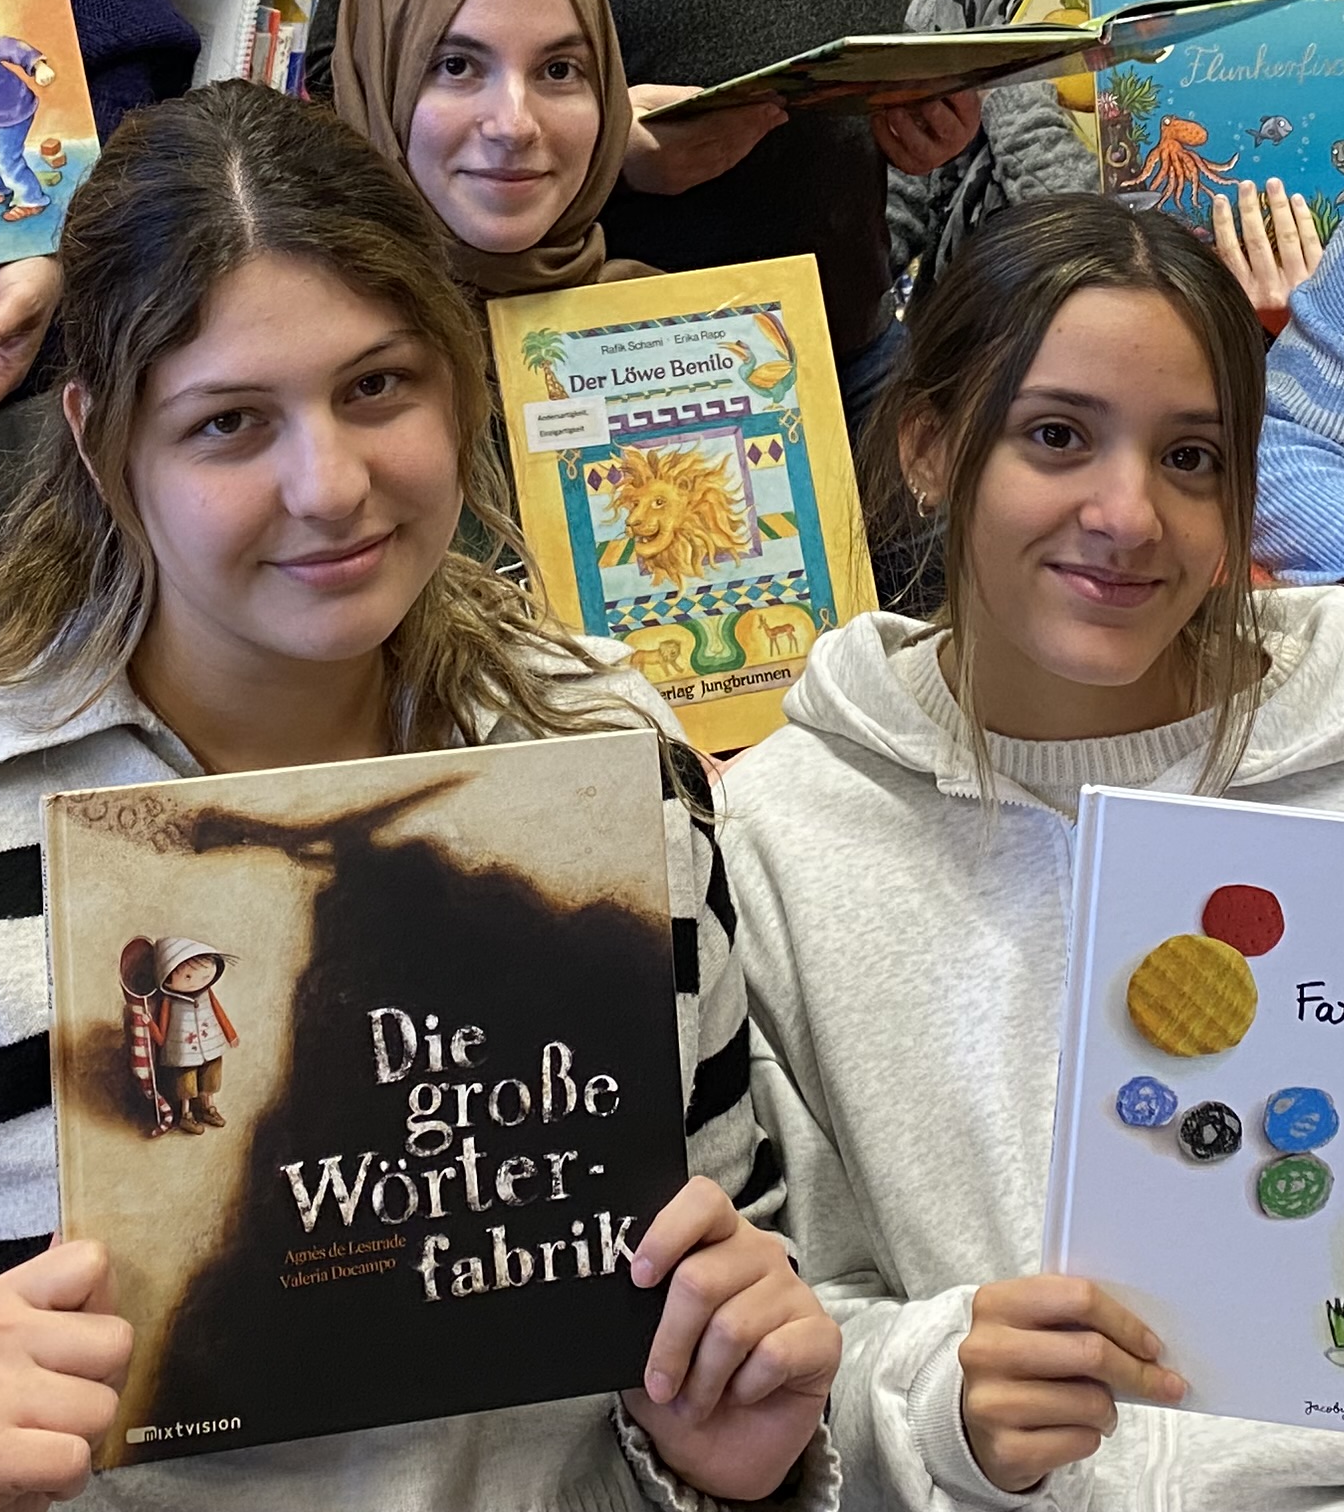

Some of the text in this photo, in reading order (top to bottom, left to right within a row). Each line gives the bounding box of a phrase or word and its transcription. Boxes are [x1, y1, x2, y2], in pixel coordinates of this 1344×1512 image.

[600, 329, 727, 356] Rafik Schami Erika Rapp
[569, 352, 734, 393] Der Löwe Benilo
[656, 664, 792, 703] erlag Jungbrunnen
[366, 1006, 487, 1086] Die
[403, 1039, 622, 1159] große
[280, 1136, 605, 1233] Wörter-
[283, 1233, 408, 1266] Agnès de Lestrade
[411, 1210, 638, 1303] fabrik
[278, 1255, 398, 1289] Valeria Docampo
[142, 1416, 242, 1443] mixtvision
